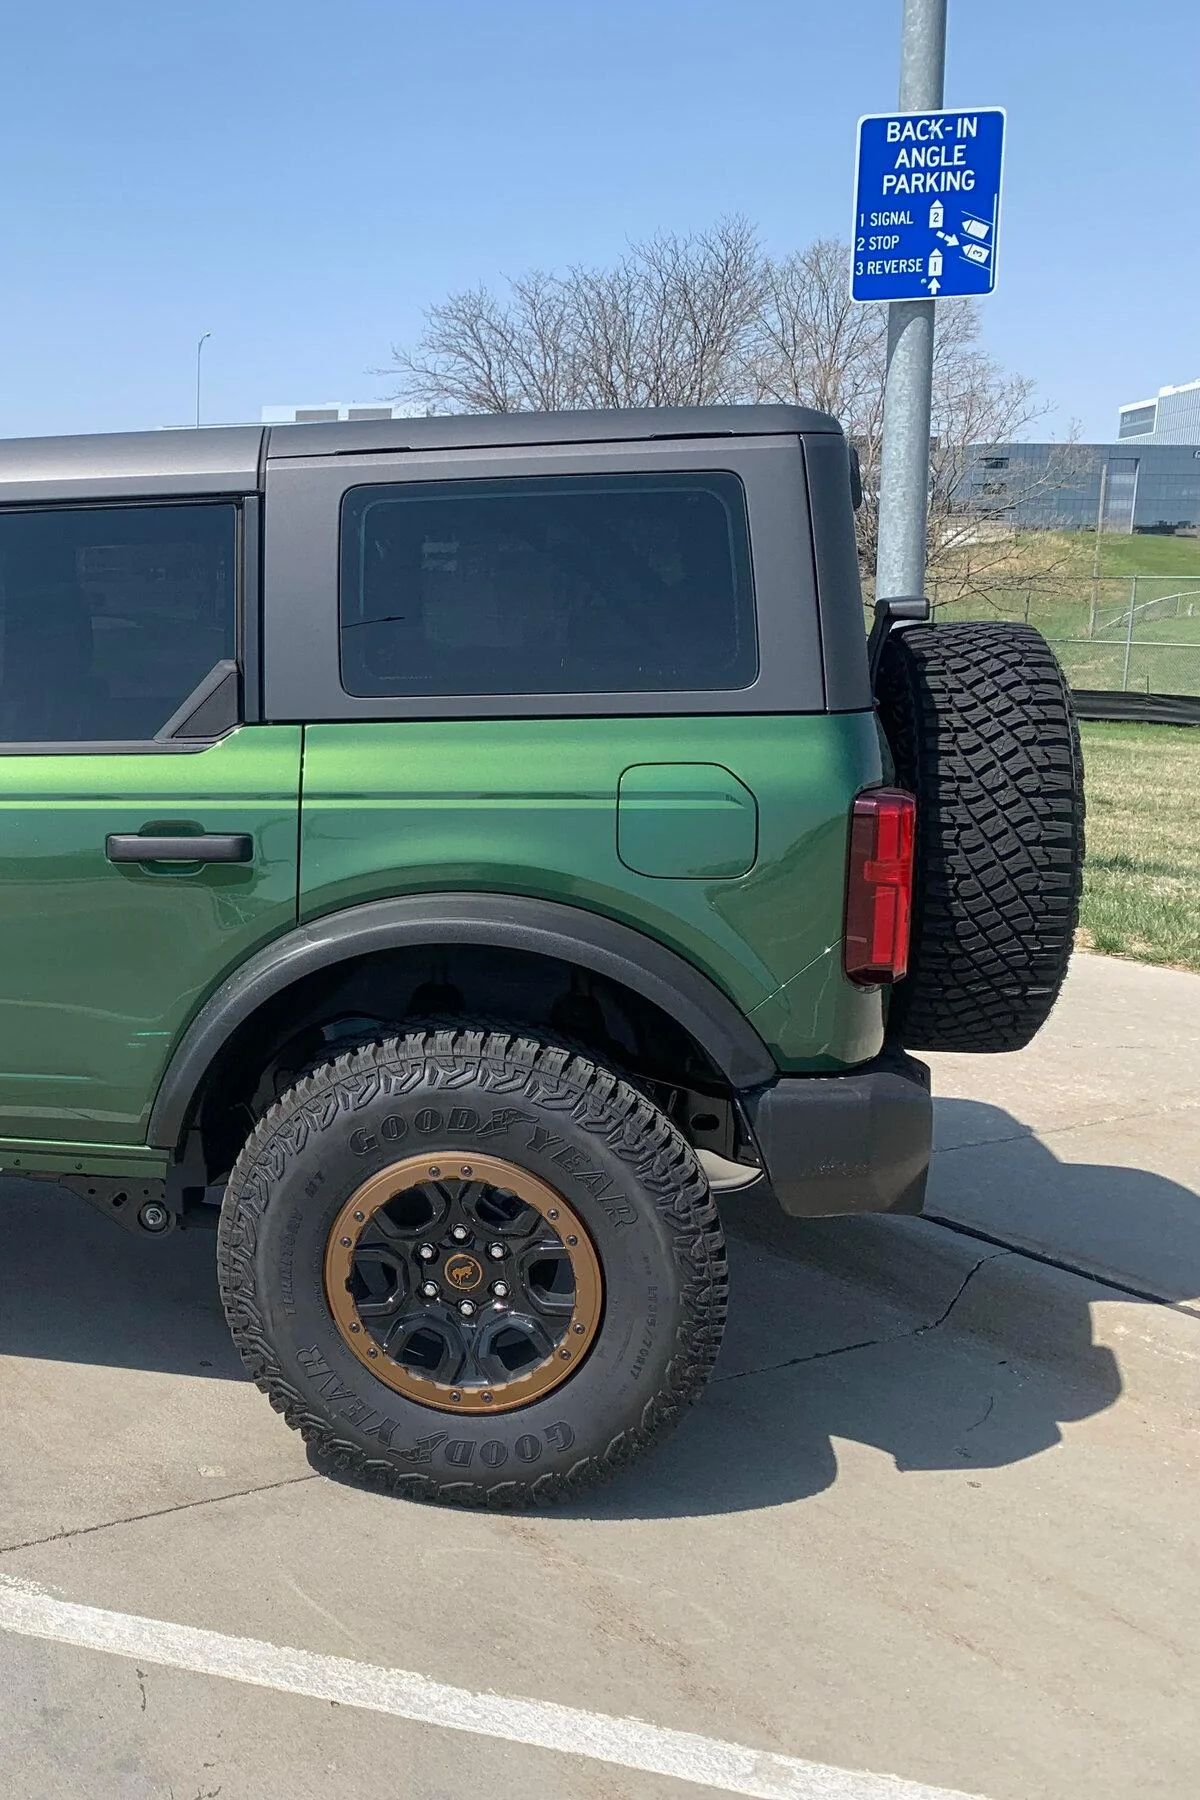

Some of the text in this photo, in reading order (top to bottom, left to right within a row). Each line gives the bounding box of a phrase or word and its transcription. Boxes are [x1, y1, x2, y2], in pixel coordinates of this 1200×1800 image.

[886, 116, 978, 143] BACK-IN
[894, 144, 967, 169] ANGLE
[882, 169, 976, 195] PARKING
[869, 210, 914, 226] SIGNAL
[856, 235, 900, 252] 2 STOP
[855, 258, 924, 276] 3 REVERSE
